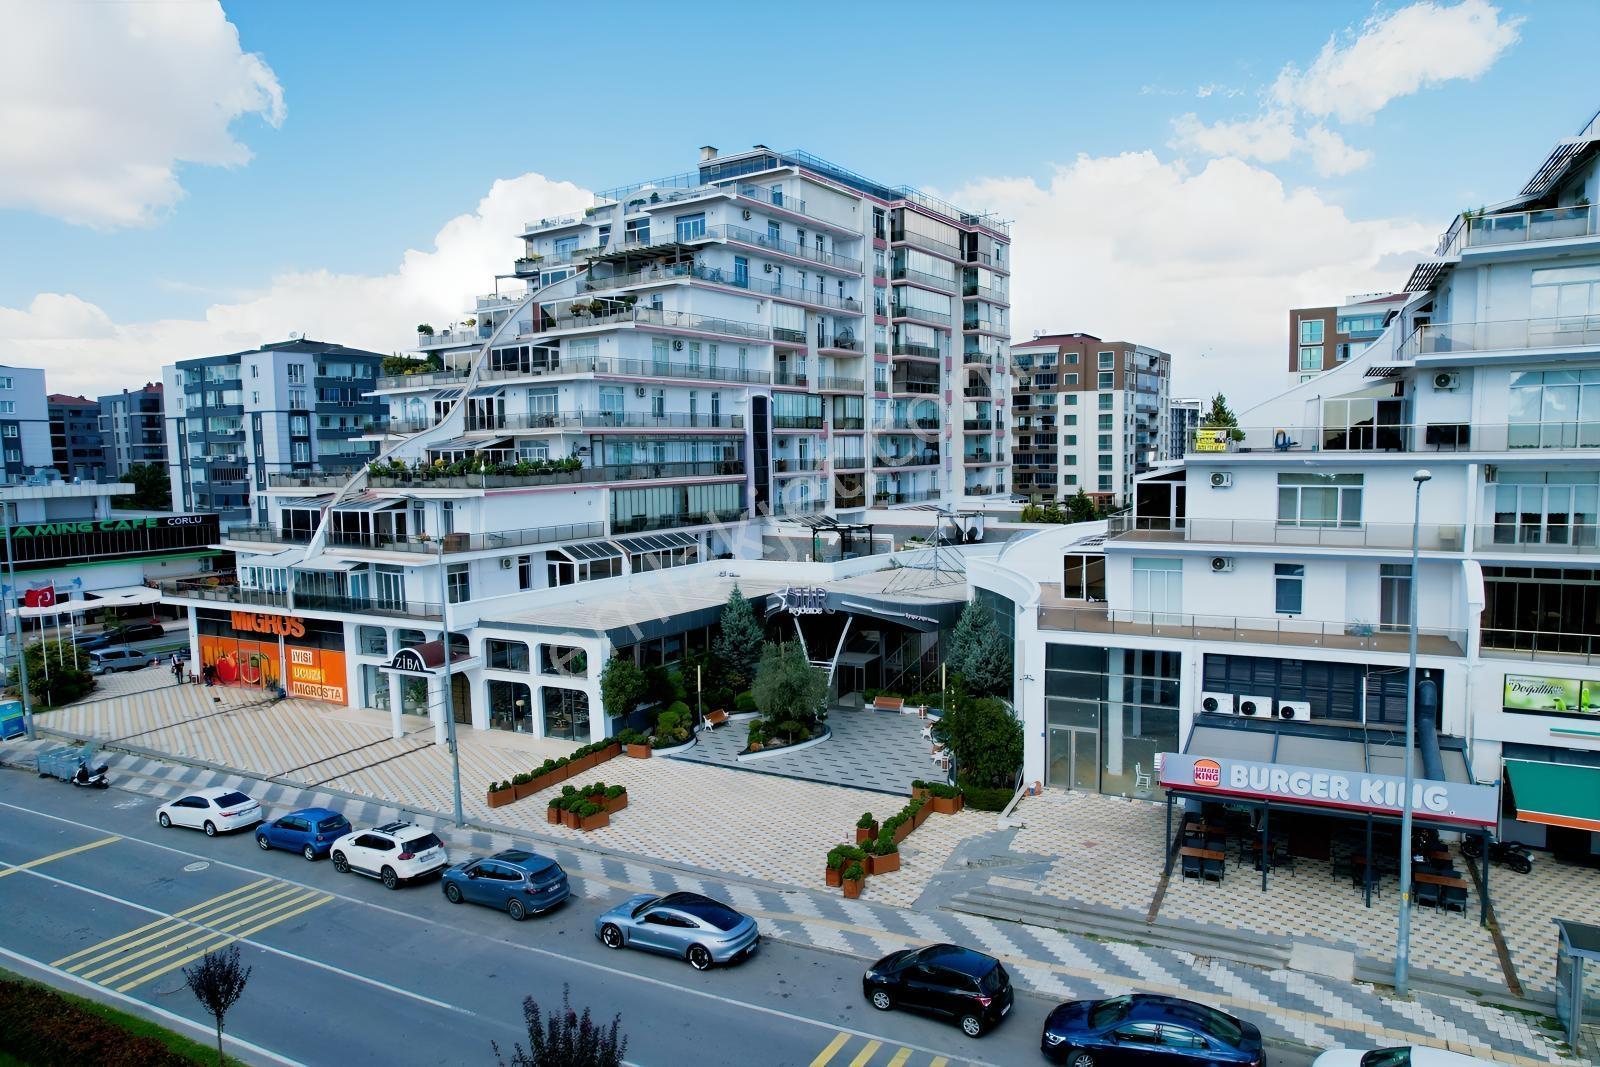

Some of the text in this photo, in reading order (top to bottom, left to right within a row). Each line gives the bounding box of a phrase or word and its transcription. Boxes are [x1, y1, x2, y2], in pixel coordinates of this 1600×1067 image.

[100, 517, 158, 531] CAFE
[783, 586, 835, 614] STAR
[231, 611, 305, 638] MIGROS
[1195, 772, 1219, 782] KING
[1230, 764, 1449, 812] BURGER KING
